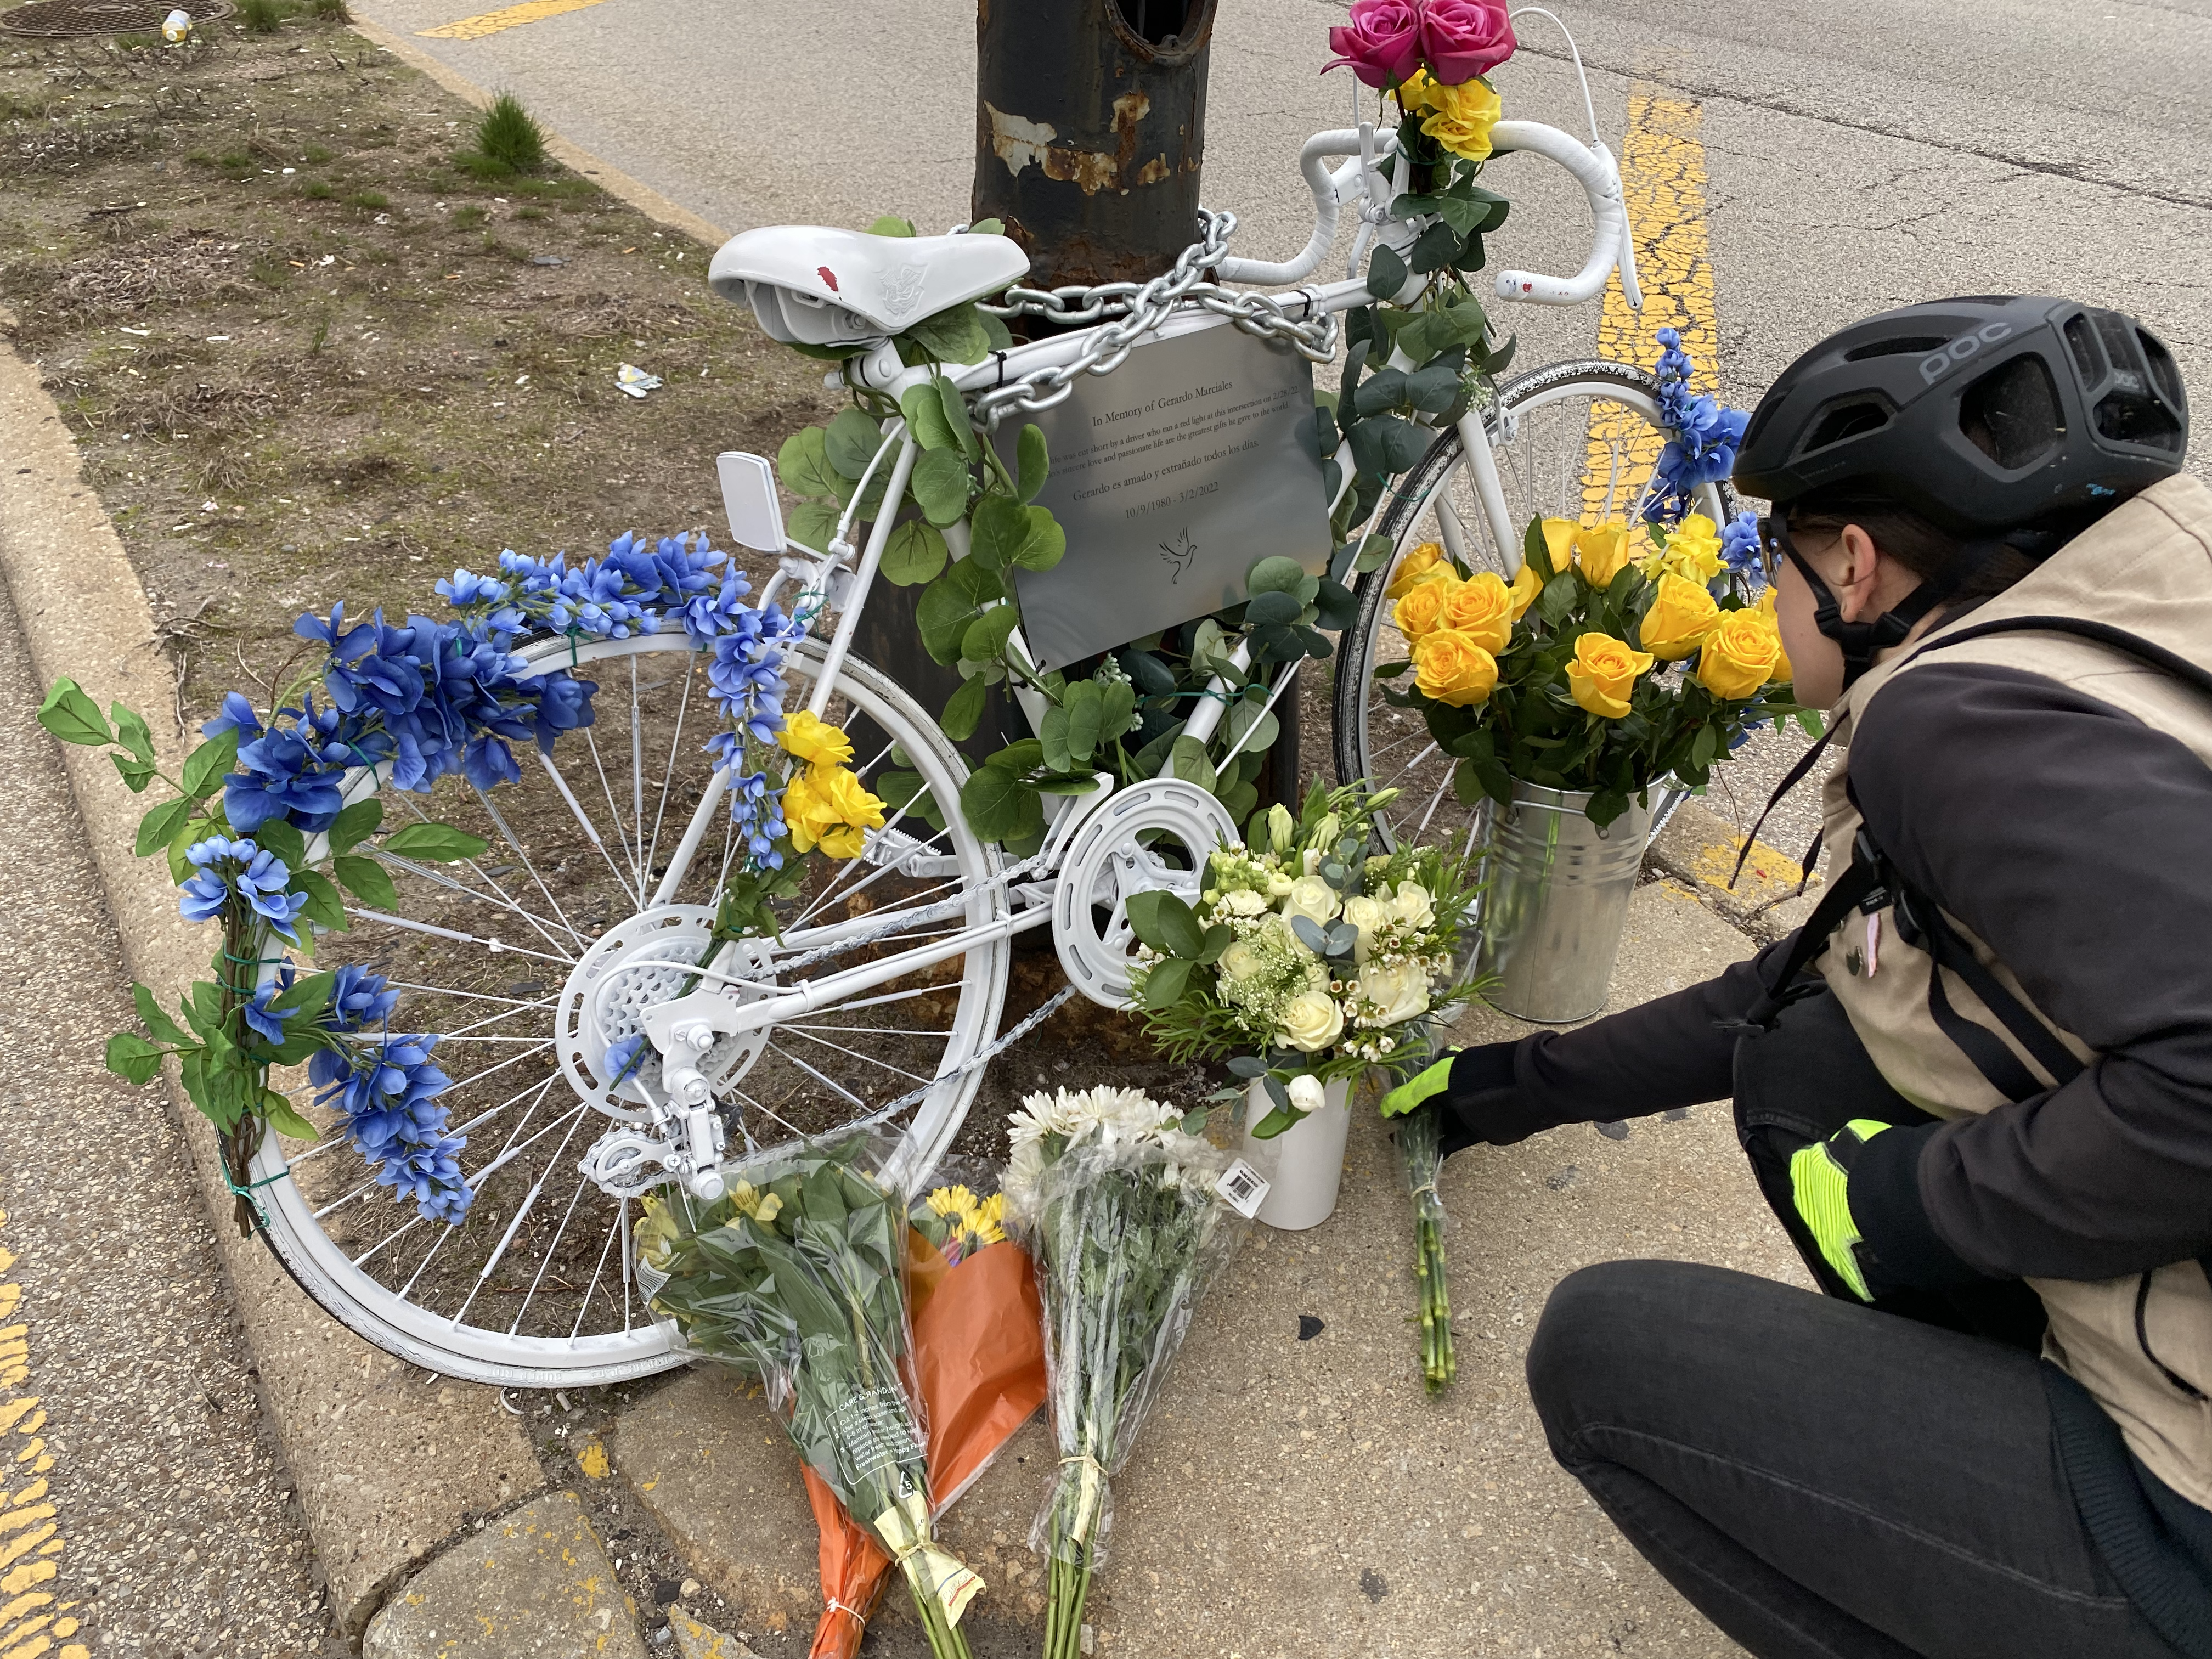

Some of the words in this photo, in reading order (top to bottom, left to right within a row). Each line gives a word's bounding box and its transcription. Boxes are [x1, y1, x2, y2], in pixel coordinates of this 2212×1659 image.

[1918, 322, 2012, 386] POC
[1092, 416, 1103, 427] In
[1105, 407, 1142, 424] Memory
[1144, 400, 1155, 412] of
[1158, 391, 1193, 408] Gerardo
[1195, 380, 1233, 398] Marciales
[1050, 455, 1061, 464] life
[1063, 452, 1076, 460] was
[1077, 449, 1089, 458] cut
[1091, 443, 1109, 454] short
[1110, 439, 1119, 449] by
[1125, 433, 1145, 443] driver
[1147, 428, 1161, 437] who
[1180, 417, 1190, 428] red
[1192, 414, 1206, 426] light
[1215, 408, 1226, 417] this
[1227, 399, 1262, 414] intersection
[1062, 462, 1086, 475] sincere
[1087, 459, 1102, 467] love
[1104, 452, 1116, 462] and
[1118, 443, 1152, 461] passionate
[1153, 438, 1164, 448] life
[1176, 433, 1187, 442] the
[1188, 426, 1212, 441] greatest
[1214, 420, 1227, 432] gifts
[1228, 418, 1236, 426] he
[1237, 414, 1251, 426] gave
[1261, 408, 1270, 416] the
[1073, 483, 1110, 501] Gerardo
[1113, 481, 1121, 489] es
[1124, 471, 1152, 487] amado
[1154, 470, 1160, 481] y
[1161, 455, 1201, 476] extrañado
[1204, 449, 1227, 464] todos
[1228, 444, 1240, 455] los
[1242, 439, 1259, 451] días.
[1125, 496, 1171, 520] 10/9/1980
[1179, 482, 1219, 503] 3/2/2022
[839, 1396, 858, 1411] CARE
[866, 1384, 899, 1398] HANDLIN
[840, 1417, 850, 1426] Cut
[850, 1410, 860, 1419] 1-2
[860, 1404, 879, 1413] inches
[843, 1424, 854, 1434] Use
[858, 1414, 872, 1423] clean
[873, 1410, 888, 1419] vase
[846, 1430, 856, 1440] 5-6
[862, 1422, 868, 1430] of
[848, 1431, 872, 1448] Maintain
[852, 1440, 872, 1455] replace
[855, 1449, 871, 1461] water
[871, 1442, 885, 1452] fresh
[856, 1450, 888, 1470] Freshwater
[893, 1446, 910, 1454] Hppy
[905, 1480, 912, 1490] 5
